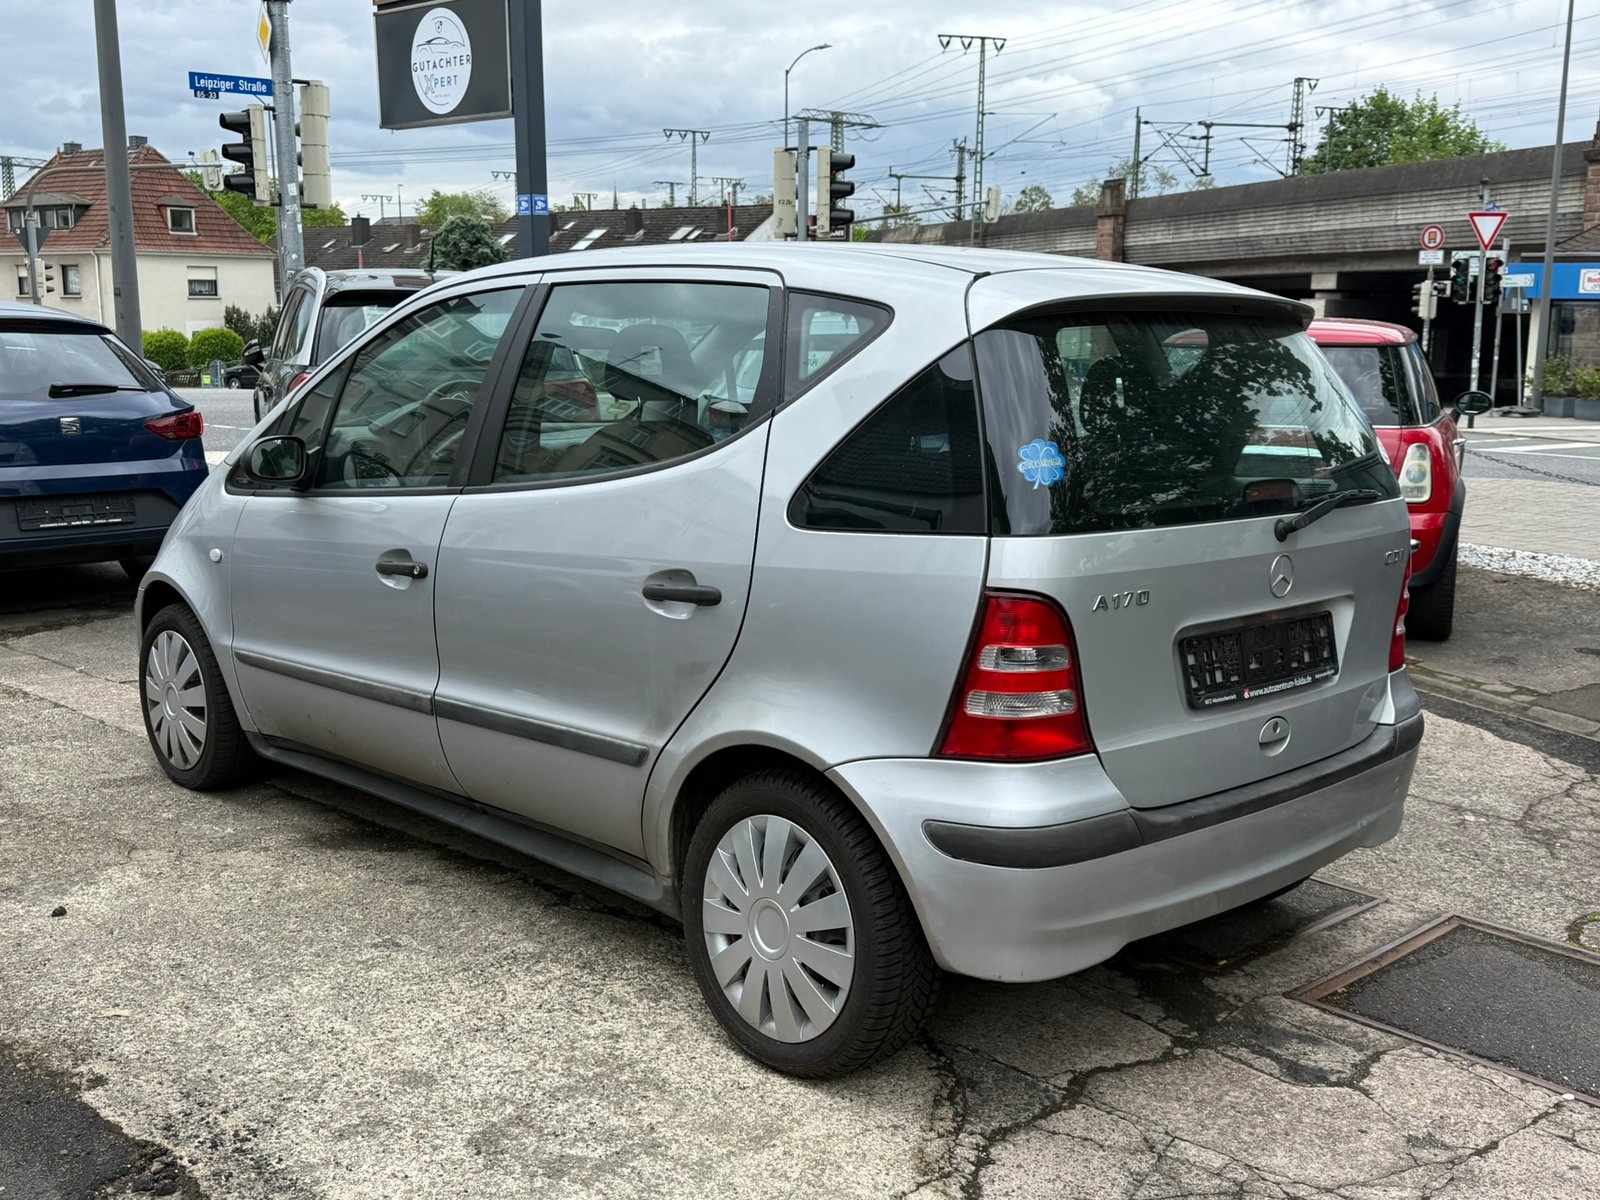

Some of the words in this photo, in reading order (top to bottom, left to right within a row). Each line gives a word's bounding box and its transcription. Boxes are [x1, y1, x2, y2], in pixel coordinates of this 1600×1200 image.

[412, 54, 472, 73] GUTACHTER
[194, 75, 235, 91] Leipziger
[238, 79, 267, 92] Straße
[424, 73, 458, 95] XPERT
[1384, 548, 1405, 565] CDI
[1248, 675, 1313, 698] www.autozentrum-fulda.de
